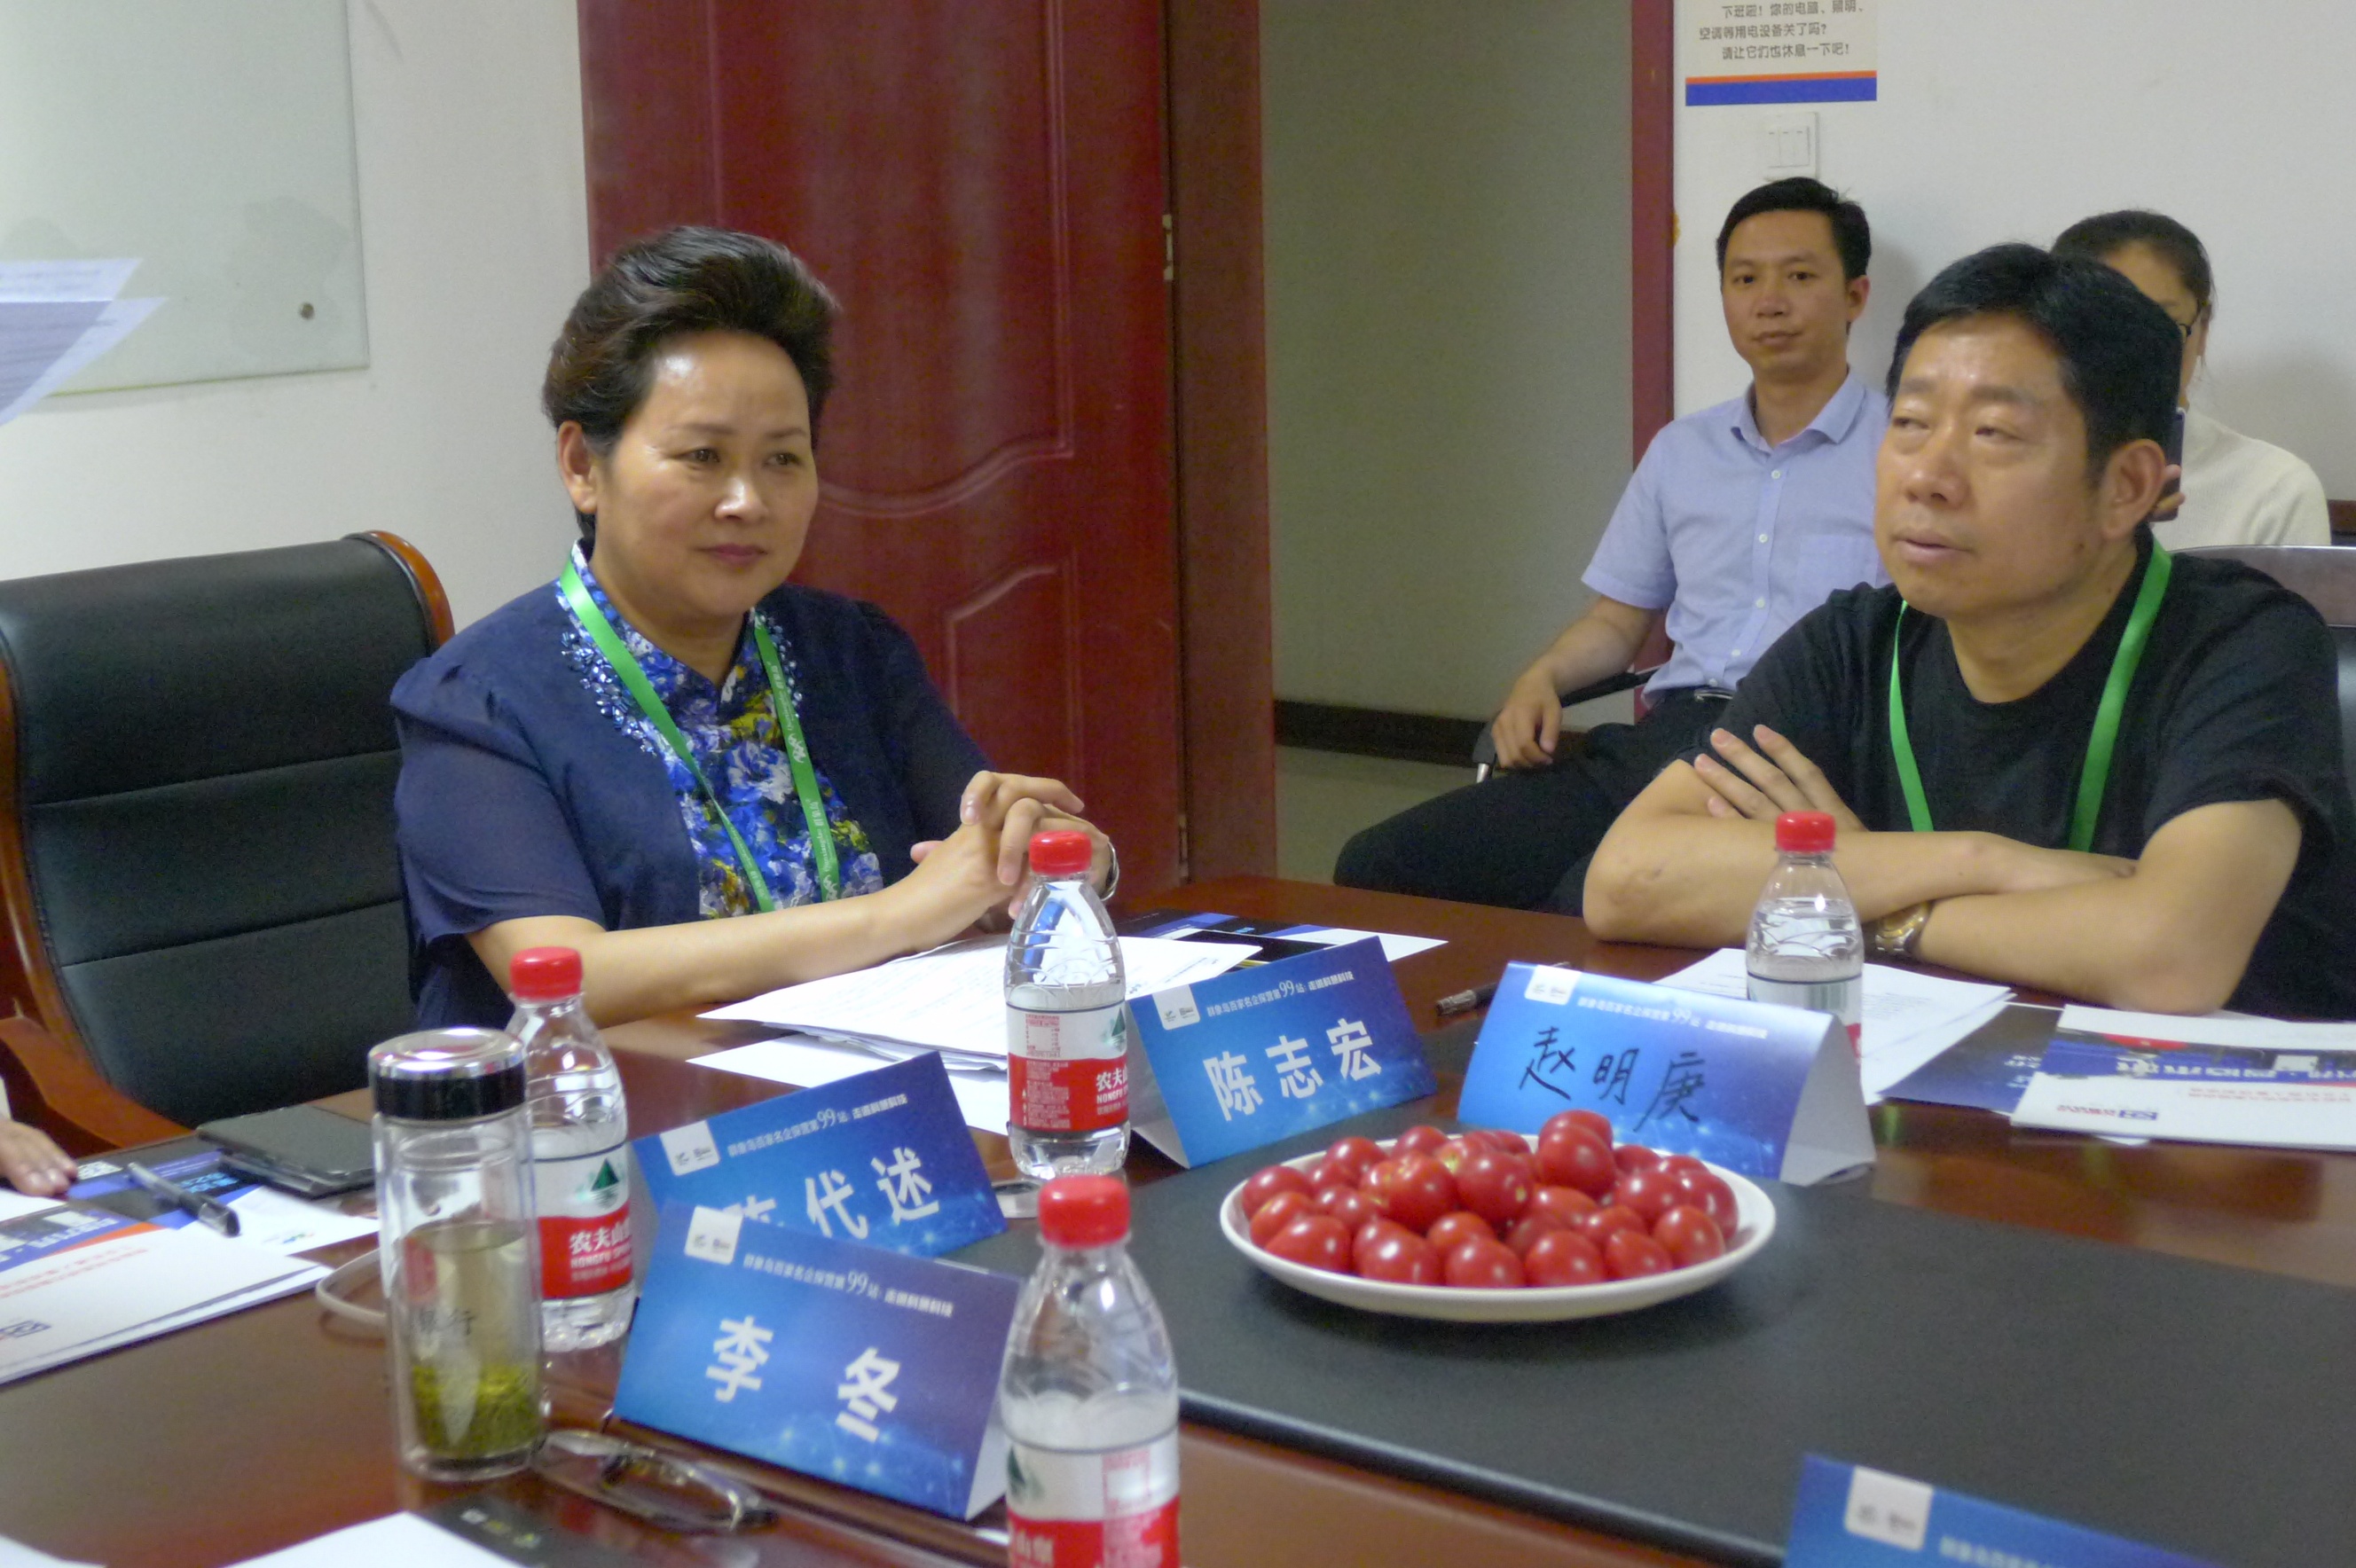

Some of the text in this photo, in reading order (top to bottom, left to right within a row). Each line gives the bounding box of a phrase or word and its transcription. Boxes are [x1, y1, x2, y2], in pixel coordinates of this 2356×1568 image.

[1203, 1017, 1383, 1122] 陈志宏
[705, 1315, 901, 1444] 李冬
